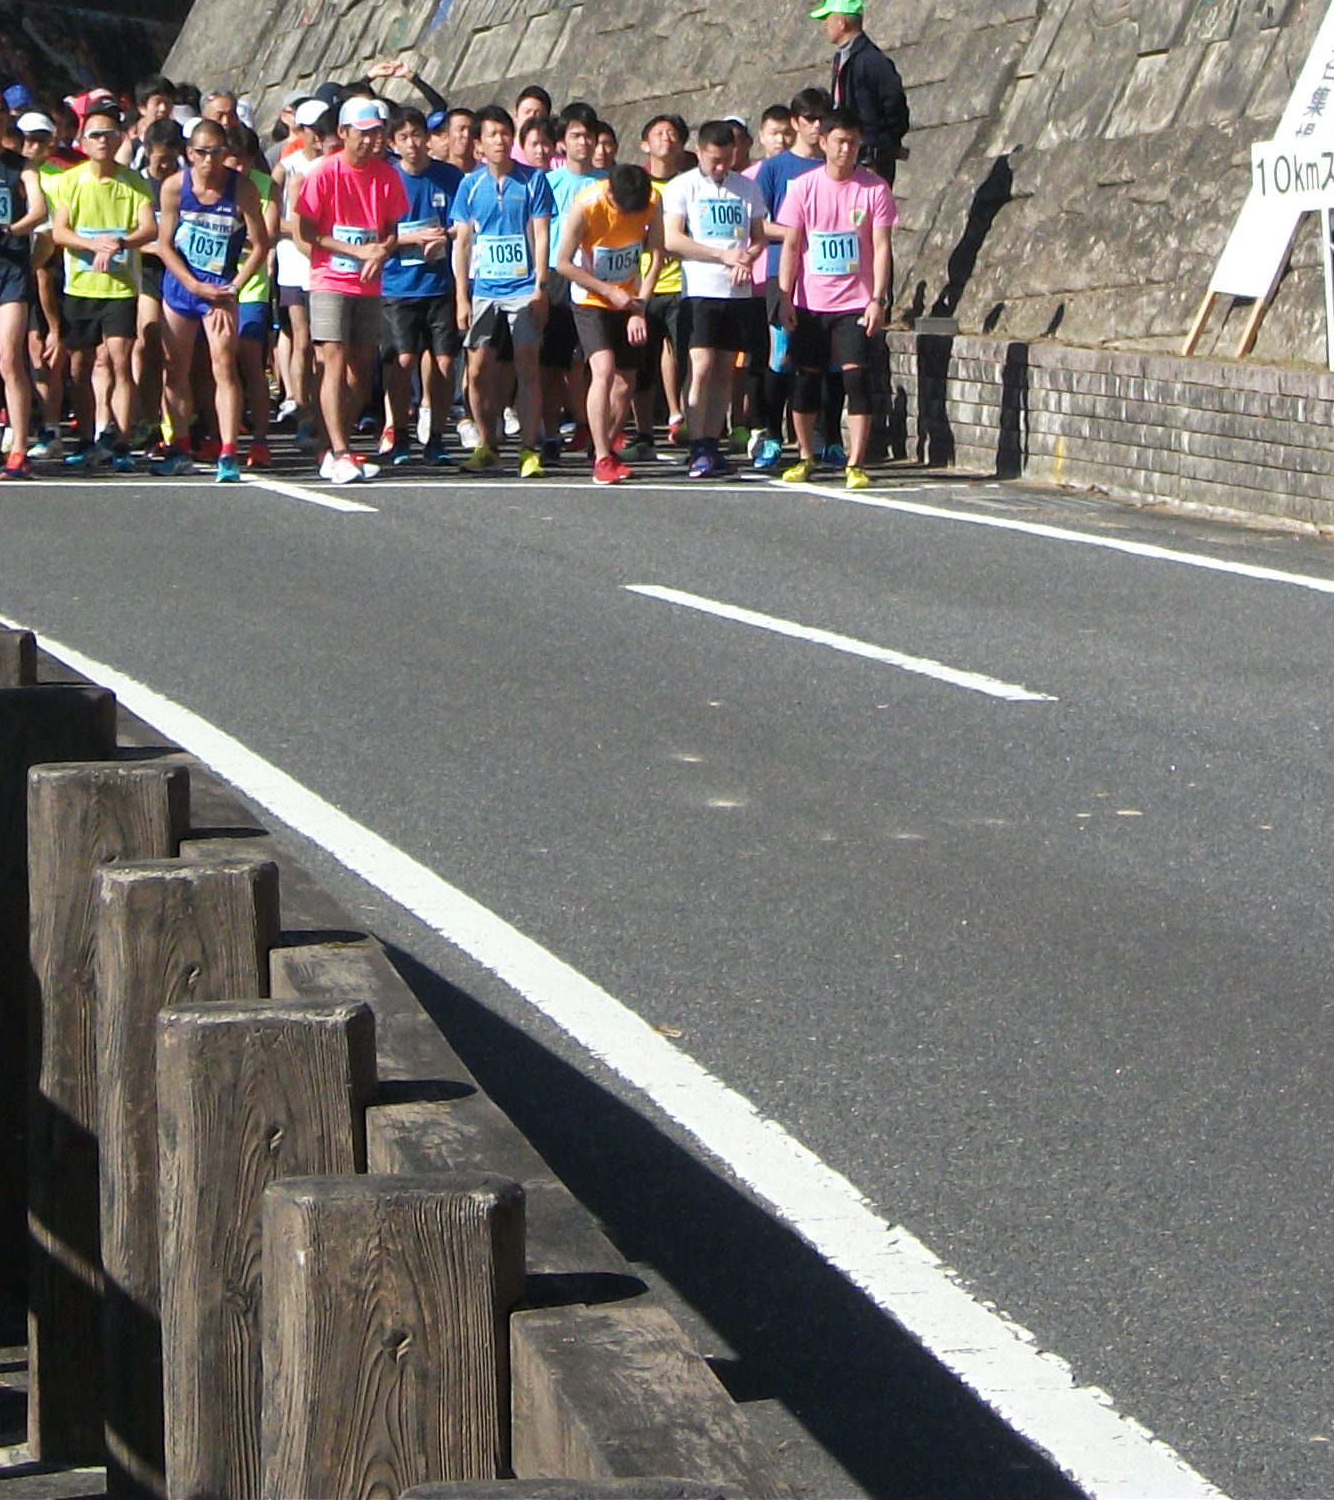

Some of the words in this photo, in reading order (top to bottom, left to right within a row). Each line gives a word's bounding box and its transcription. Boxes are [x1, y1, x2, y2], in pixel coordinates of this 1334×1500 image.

[710, 204, 742, 225] 1006
[188, 232, 224, 258] 1037
[488, 242, 523, 263] 1036
[821, 238, 854, 259] 1011
[607, 250, 640, 272] 1054
